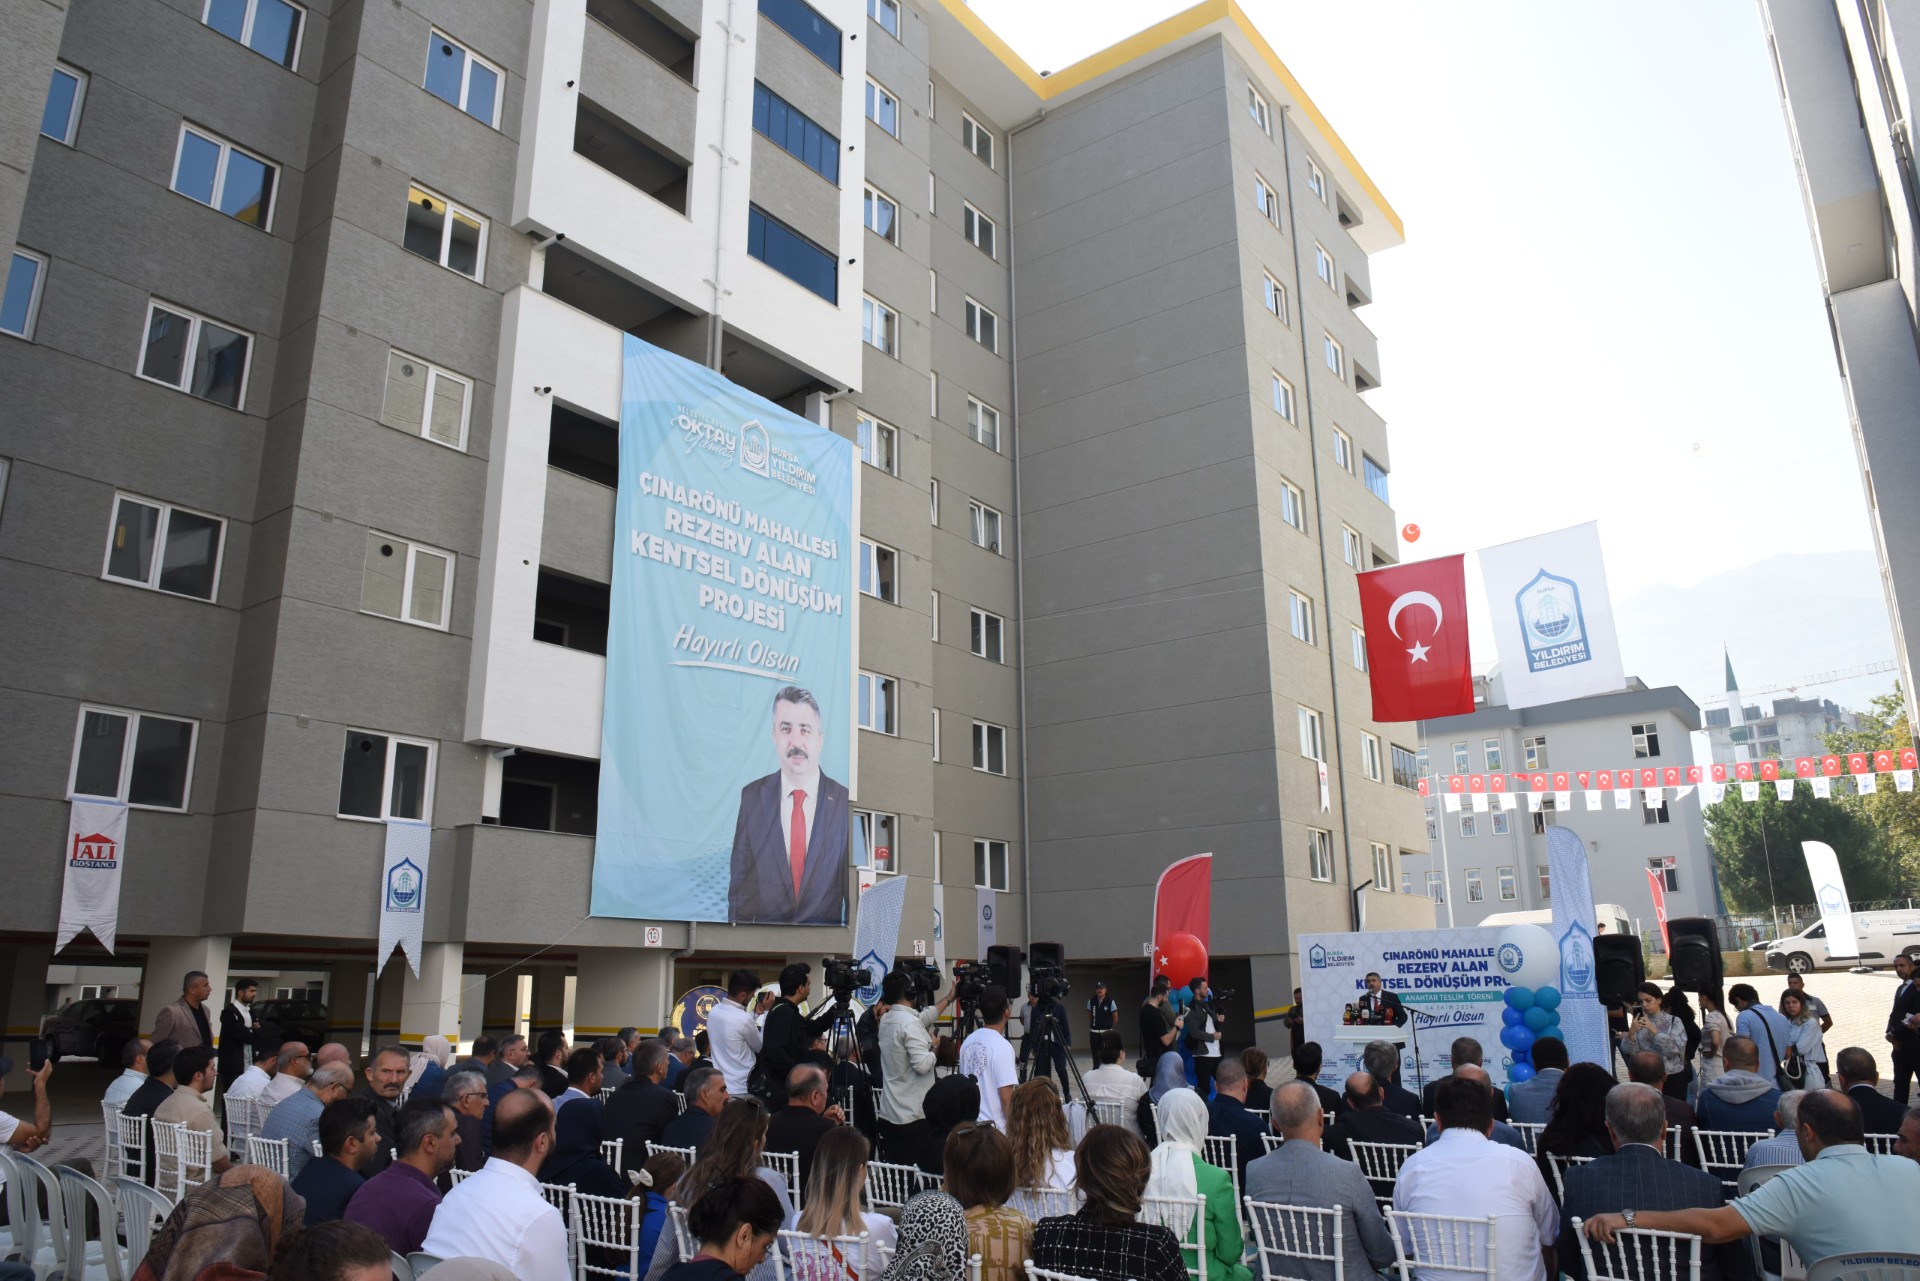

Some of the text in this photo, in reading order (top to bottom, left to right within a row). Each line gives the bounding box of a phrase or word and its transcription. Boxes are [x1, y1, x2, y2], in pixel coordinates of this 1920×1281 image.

[671, 414, 736, 450] OKTAY
[772, 445, 800, 465] BURSA
[772, 456, 816, 484] YILDIRIM
[639, 471, 838, 560] ÇINARÖNÜ MAHALLESİ
[665, 507, 811, 579] REZERV ALAN
[631, 529, 842, 616] KENTSEL DÖNÜŞÜM
[699, 584, 785, 632] PROJESİ
[673, 622, 800, 674] Hayırlı Olsun
[1531, 642, 1585, 661] YILDIRIM
[1533, 652, 1587, 670] BELEDİYESİ
[72, 860, 115, 868] BOSTANCI
[1382, 948, 1439, 963] ÇINARÖNÜ
[1397, 961, 1489, 974] REZERV ALAN
[1414, 973, 1481, 989] DÖNÜŞÜM
[1405, 990, 1494, 1002] ANAHTAR TESLİM TÖRENİ
[1414, 1010, 1485, 1026] Hayırlı Olsun
[1840, 1257, 1885, 1266] YILDIRIM
